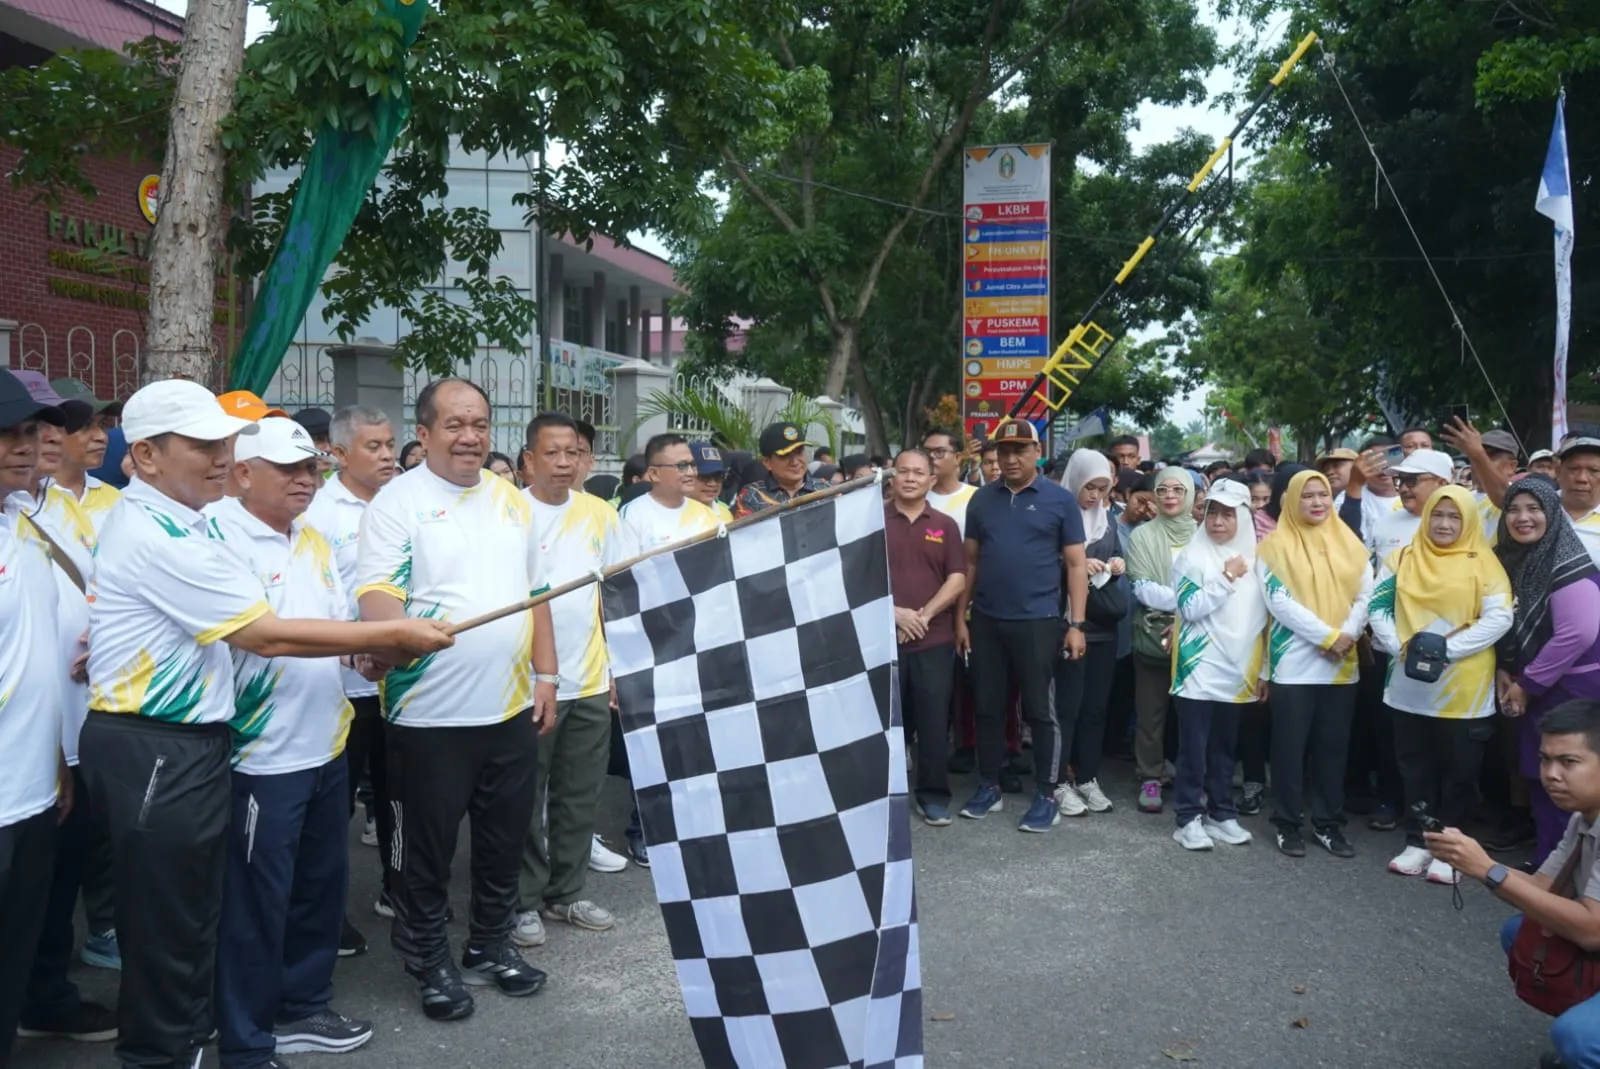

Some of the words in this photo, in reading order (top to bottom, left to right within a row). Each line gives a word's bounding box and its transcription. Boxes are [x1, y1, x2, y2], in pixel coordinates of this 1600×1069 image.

[998, 204, 1030, 216] LKBH
[987, 318, 1040, 329] PUSKEMA
[1000, 336, 1026, 347] BEM
[997, 359, 1031, 369] HMPS
[1000, 380, 1027, 391] DPM
